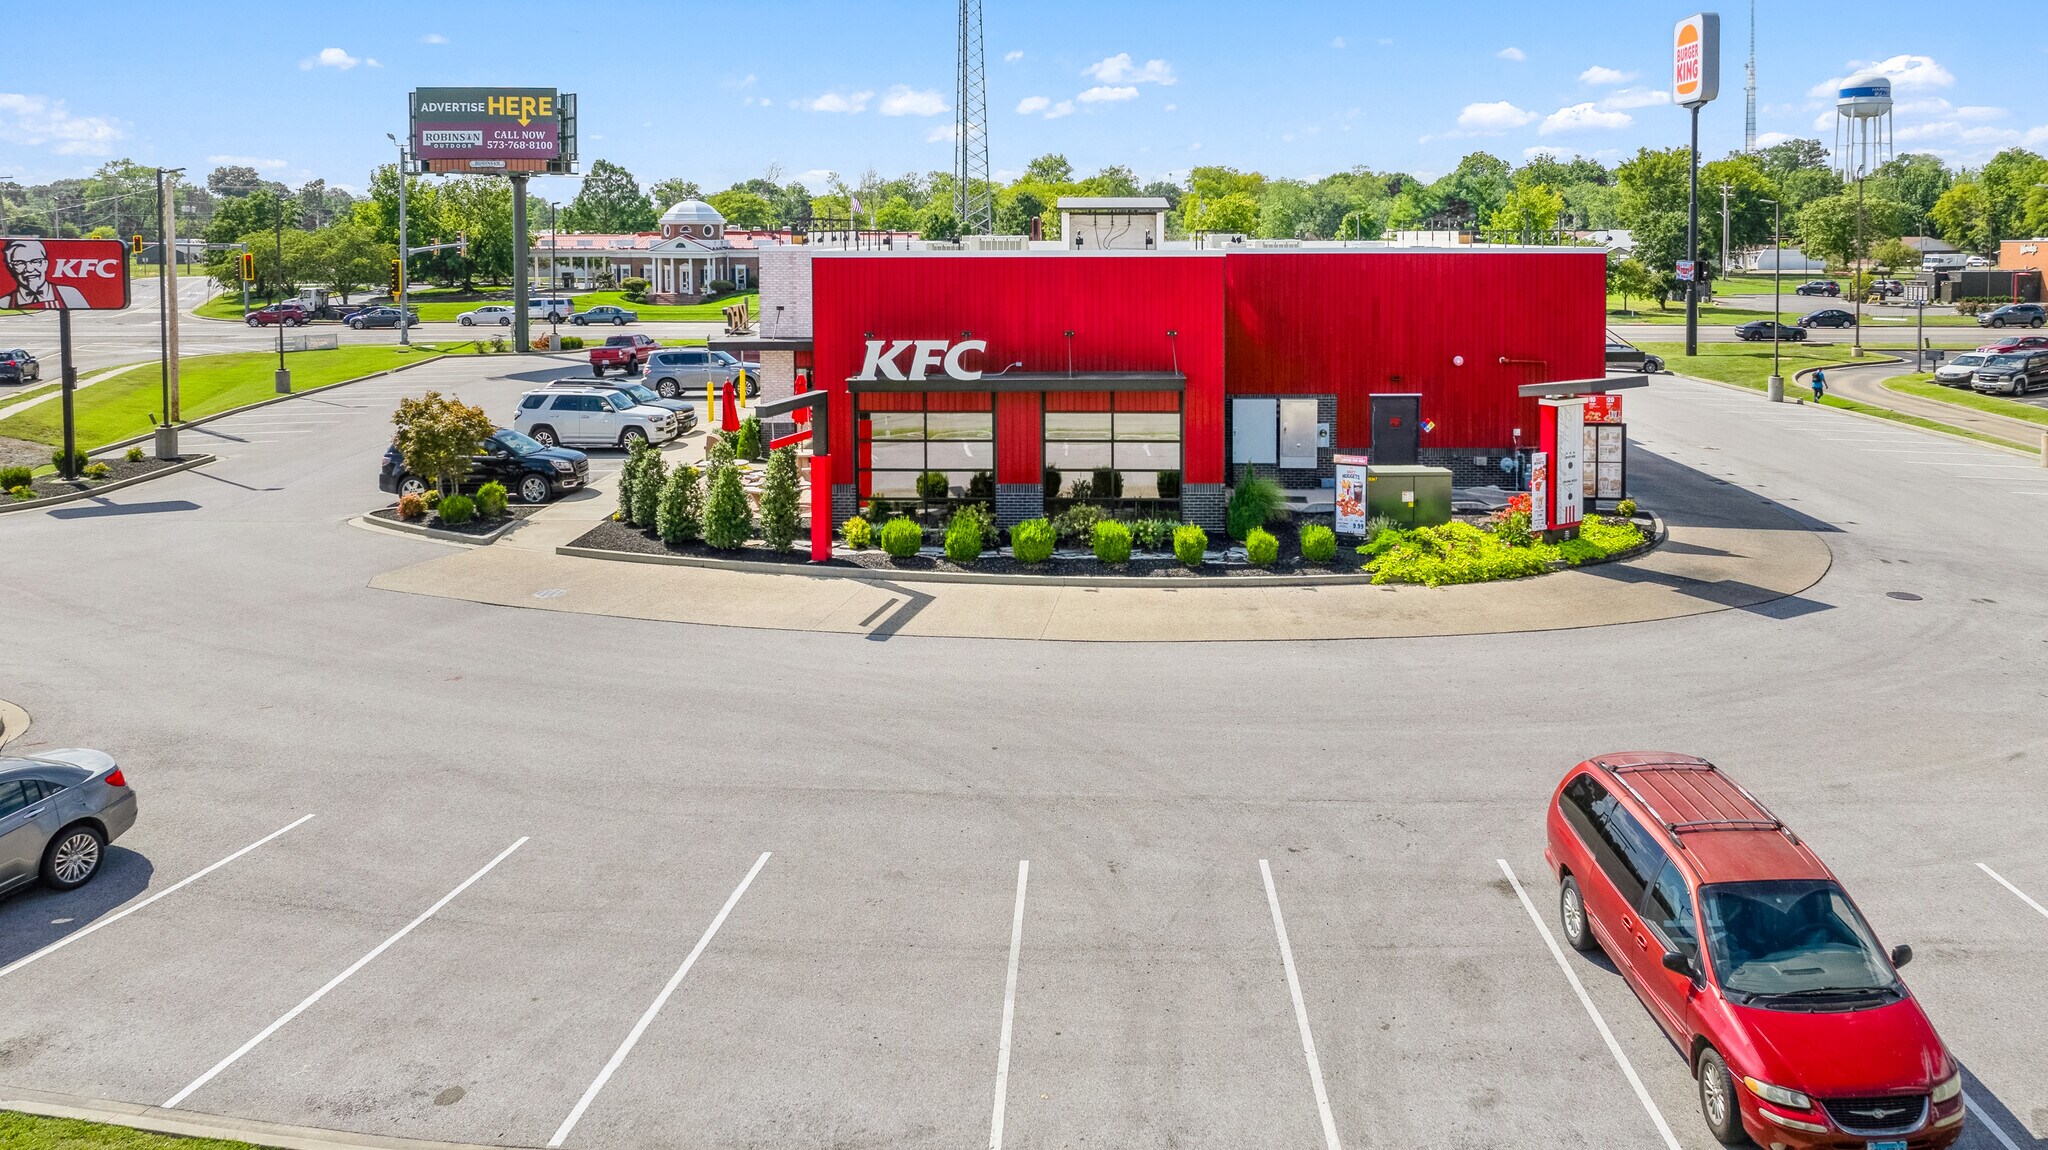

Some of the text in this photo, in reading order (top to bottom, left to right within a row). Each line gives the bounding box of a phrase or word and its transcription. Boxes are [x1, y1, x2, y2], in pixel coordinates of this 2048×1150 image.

[1676, 43, 1699, 63] BURGER
[1676, 58, 1699, 83] KING
[420, 96, 553, 117] ADVERTISE HERE
[425, 133, 481, 142] ROBINSON
[487, 140, 553, 150] 573-768-8100
[494, 130, 546, 140] CALL NOW
[52, 258, 117, 279] KFC
[856, 339, 988, 381] KFC
